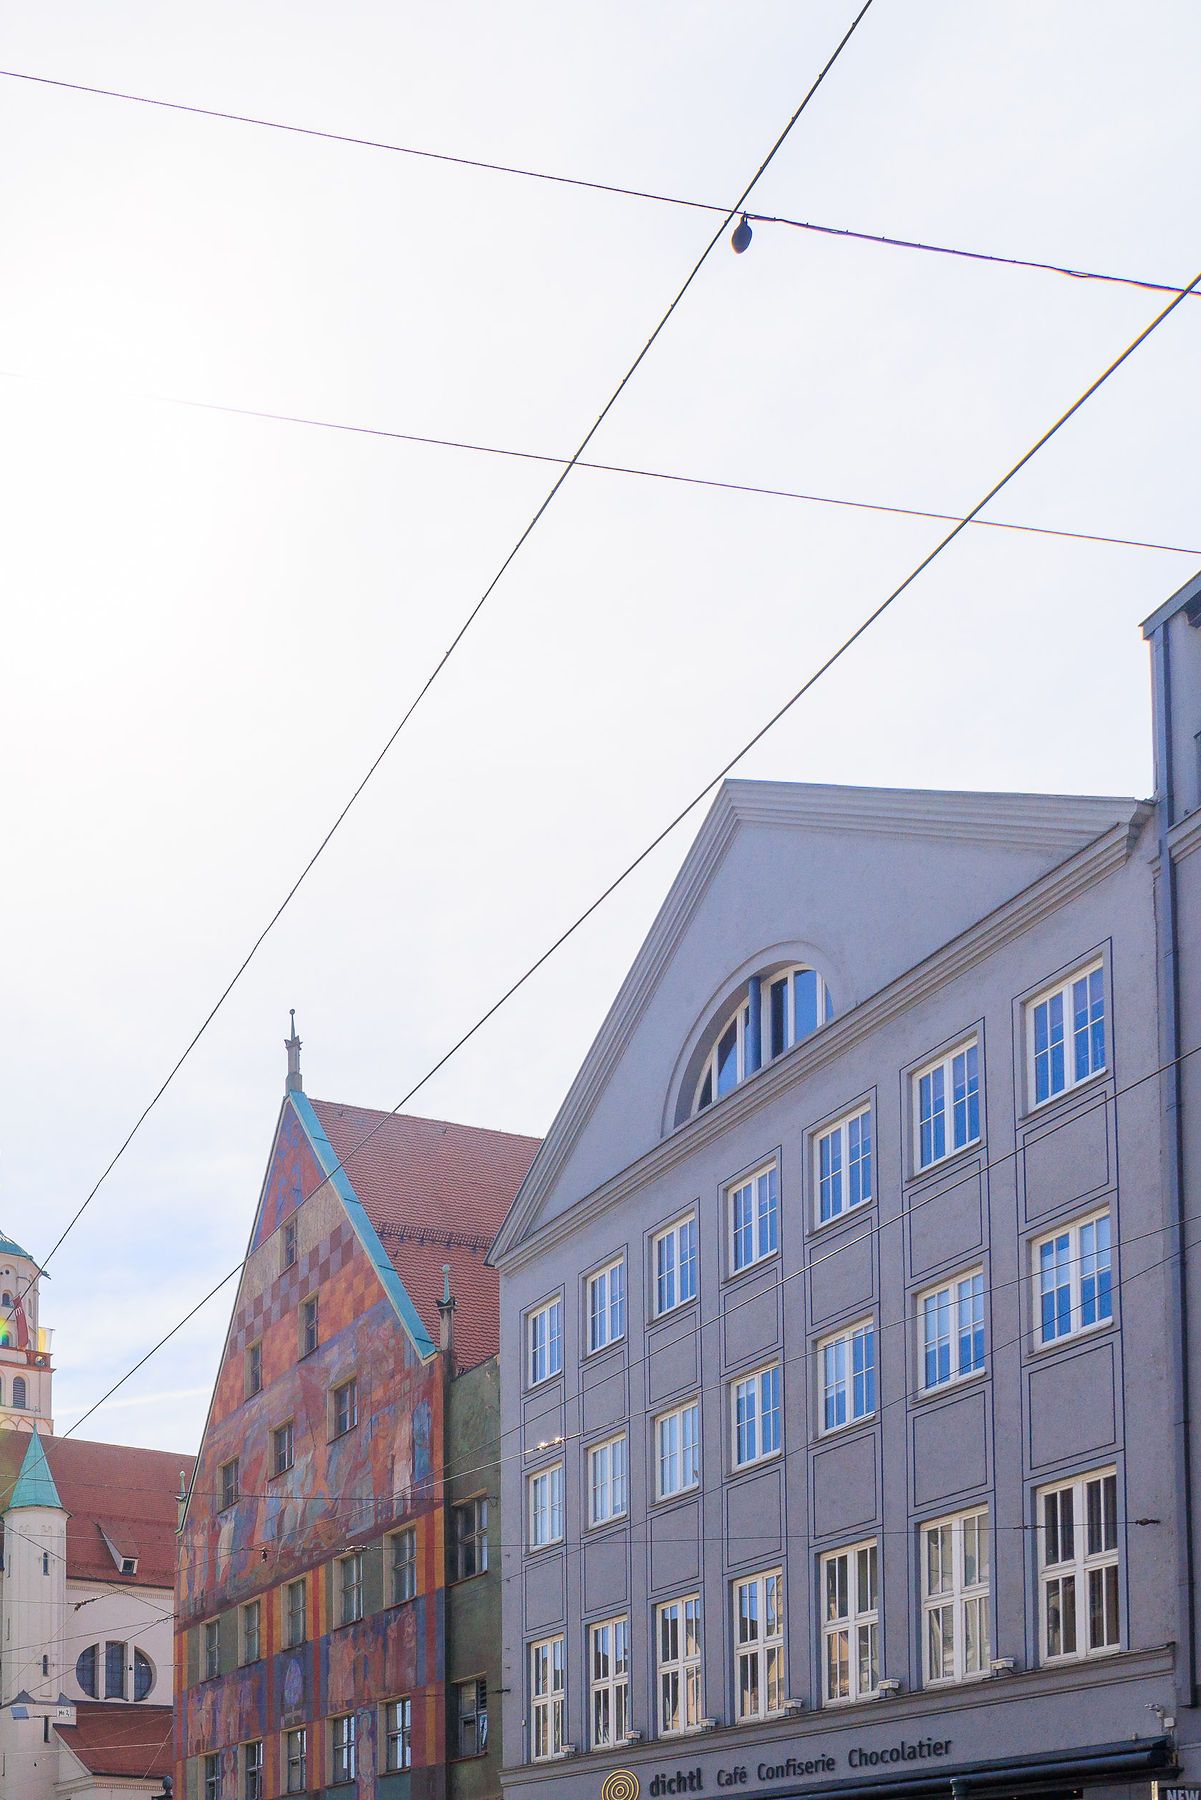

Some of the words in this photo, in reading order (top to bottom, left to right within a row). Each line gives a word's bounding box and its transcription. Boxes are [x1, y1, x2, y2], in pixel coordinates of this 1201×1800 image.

[649, 1768, 704, 1797] dichtl
[716, 1765, 747, 1788] Café
[757, 1753, 836, 1782] Confiserie
[847, 1737, 953, 1768] Chocolatier
